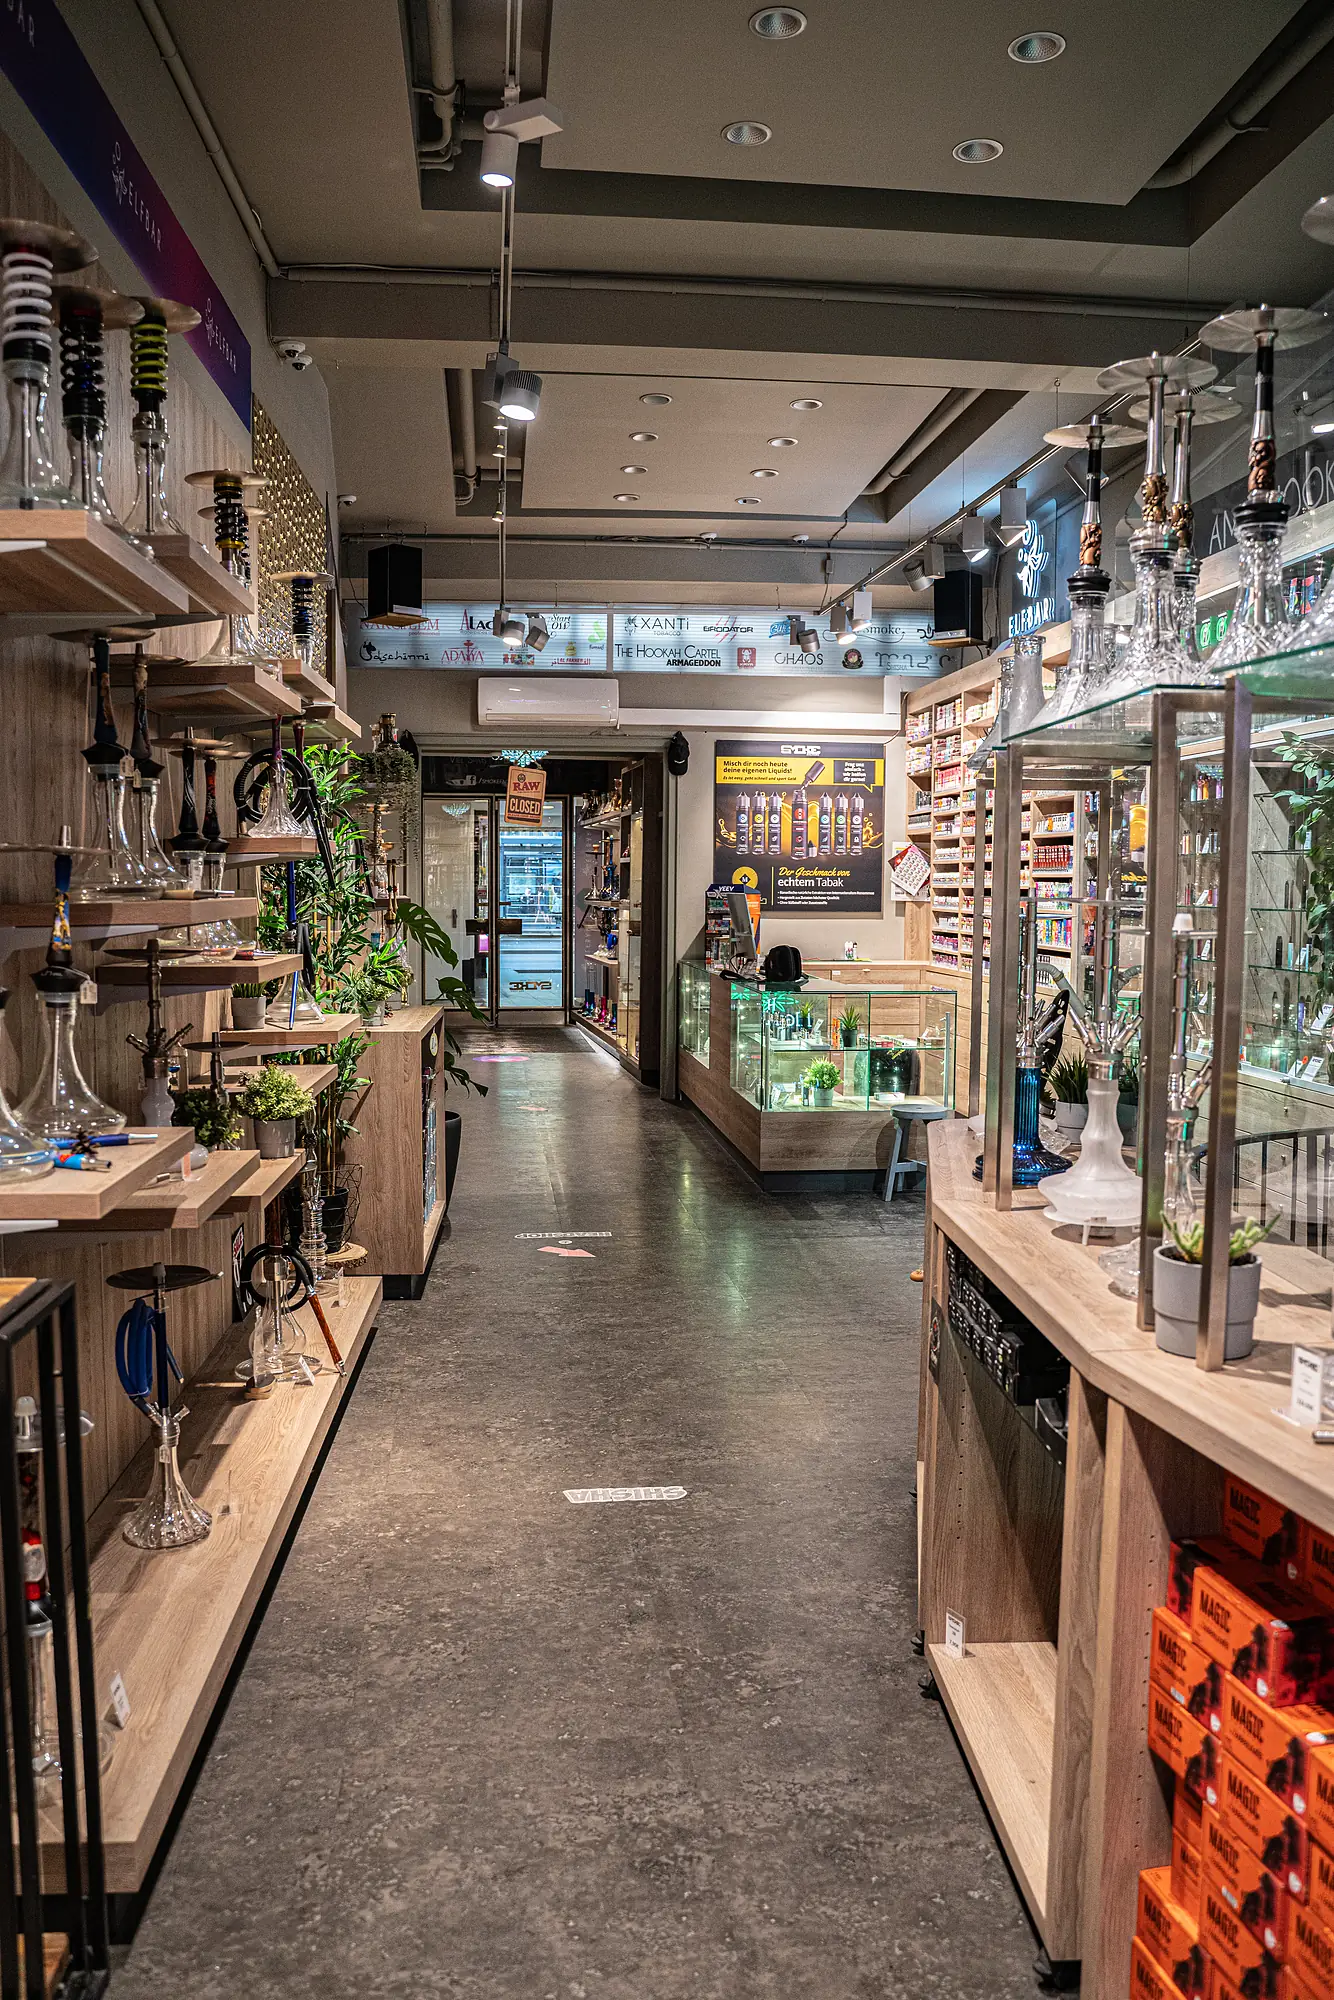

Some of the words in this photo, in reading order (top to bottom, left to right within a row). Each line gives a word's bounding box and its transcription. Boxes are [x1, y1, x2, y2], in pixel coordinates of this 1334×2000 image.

[128, 181, 162, 252] ELFBAR
[215, 325, 237, 374] ELFBAR
[1009, 598, 1052, 637] ELFBAR
[666, 659, 721, 667] ARMAGEDDON
[774, 652, 824, 666] CHAOS
[510, 798, 541, 815] CLOSED
[512, 781, 542, 792] RAW
[777, 876, 815, 887] echtem
[815, 877, 844, 887] Tabak
[778, 866, 795, 876] Der
[795, 866, 837, 879] Geschmack
[562, 1485, 688, 1504] SHISHA
[1200, 1589, 1231, 1634] MAGIC
[1158, 1630, 1187, 1672] MAGIC
[1154, 1699, 1183, 1743] MAGIC
[1231, 1695, 1264, 1744] MAGIC
[1228, 1769, 1261, 1820] MAGIC
[1209, 1822, 1240, 1875] MAGIC
[1143, 1894, 1171, 1945] MAGIC
[1207, 1894, 1239, 1949] MAGIC
